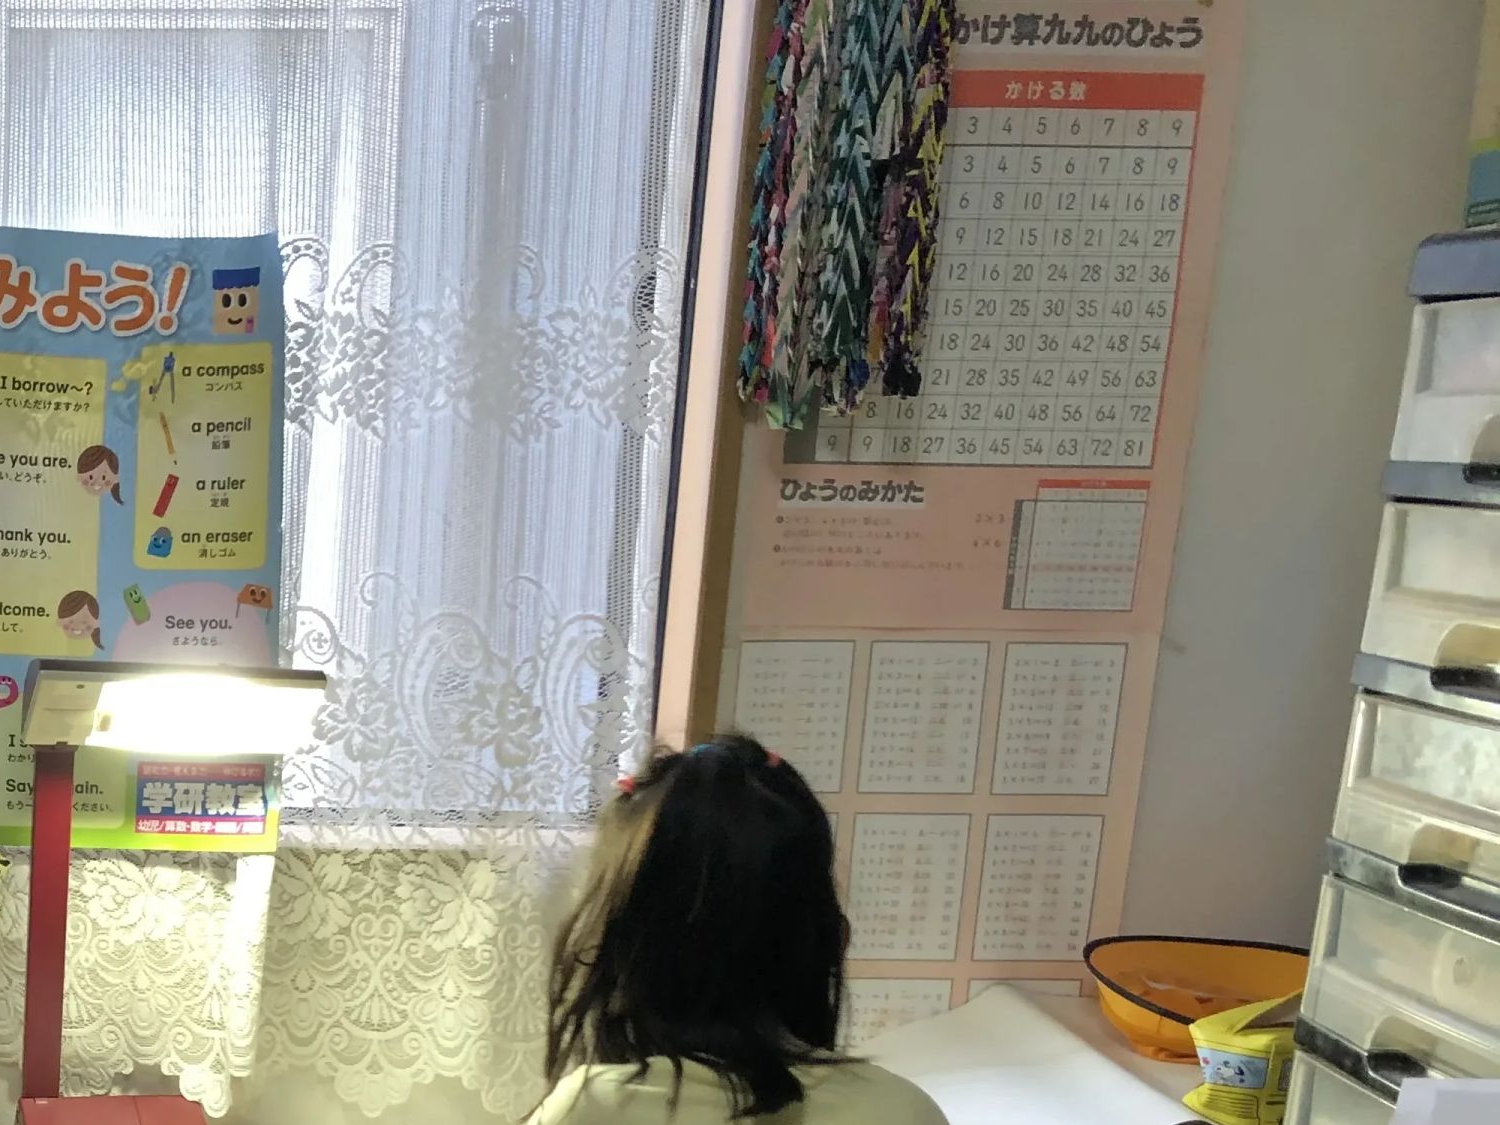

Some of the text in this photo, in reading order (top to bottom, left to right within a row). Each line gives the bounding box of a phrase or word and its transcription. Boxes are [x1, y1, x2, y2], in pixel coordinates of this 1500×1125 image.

[1006, 81, 1086, 100] かける数
[968, 116, 1182, 136] 3 4 5 6 7 8 9
[959, 192, 1180, 211] 6 8 10 12 14 16 18
[956, 227, 1175, 247] 9 12 15 18 21 24 27
[949, 263, 1170, 282] 12 16 20 24 28 32 36
[945, 299, 1166, 318] 15 20 25 30 35 40 45
[940, 333, 1160, 352] 18 24 30 36 42 48 54
[182, 363, 264, 379] a compass
[932, 369, 1156, 387] 21 28 35 42 49 56 63
[0, 376, 7, 389] I
[206, 382, 242, 391] コンパス
[927, 403, 1151, 422] 24 32 40 48 56 64 72
[192, 418, 251, 436] a pencil
[212, 440, 230, 449] 鉛筆
[923, 437, 1143, 456] 27 36 45 54 63 72 81
[10, 455, 37, 468] you
[43, 457, 71, 468] are.
[196, 477, 245, 490] a ruler
[780, 479, 924, 503] ひょうのみかた
[38, 533, 70, 546] you.
[181, 532, 252, 543] an eraser
[1, 548, 47, 559] ありがとう。
[199, 548, 236, 558] 消しゴム
[165, 616, 232, 632] See you.
[173, 636, 217, 646] さようなら。
[9, 734, 15, 747] I
[142, 782, 265, 816] 学研教室
